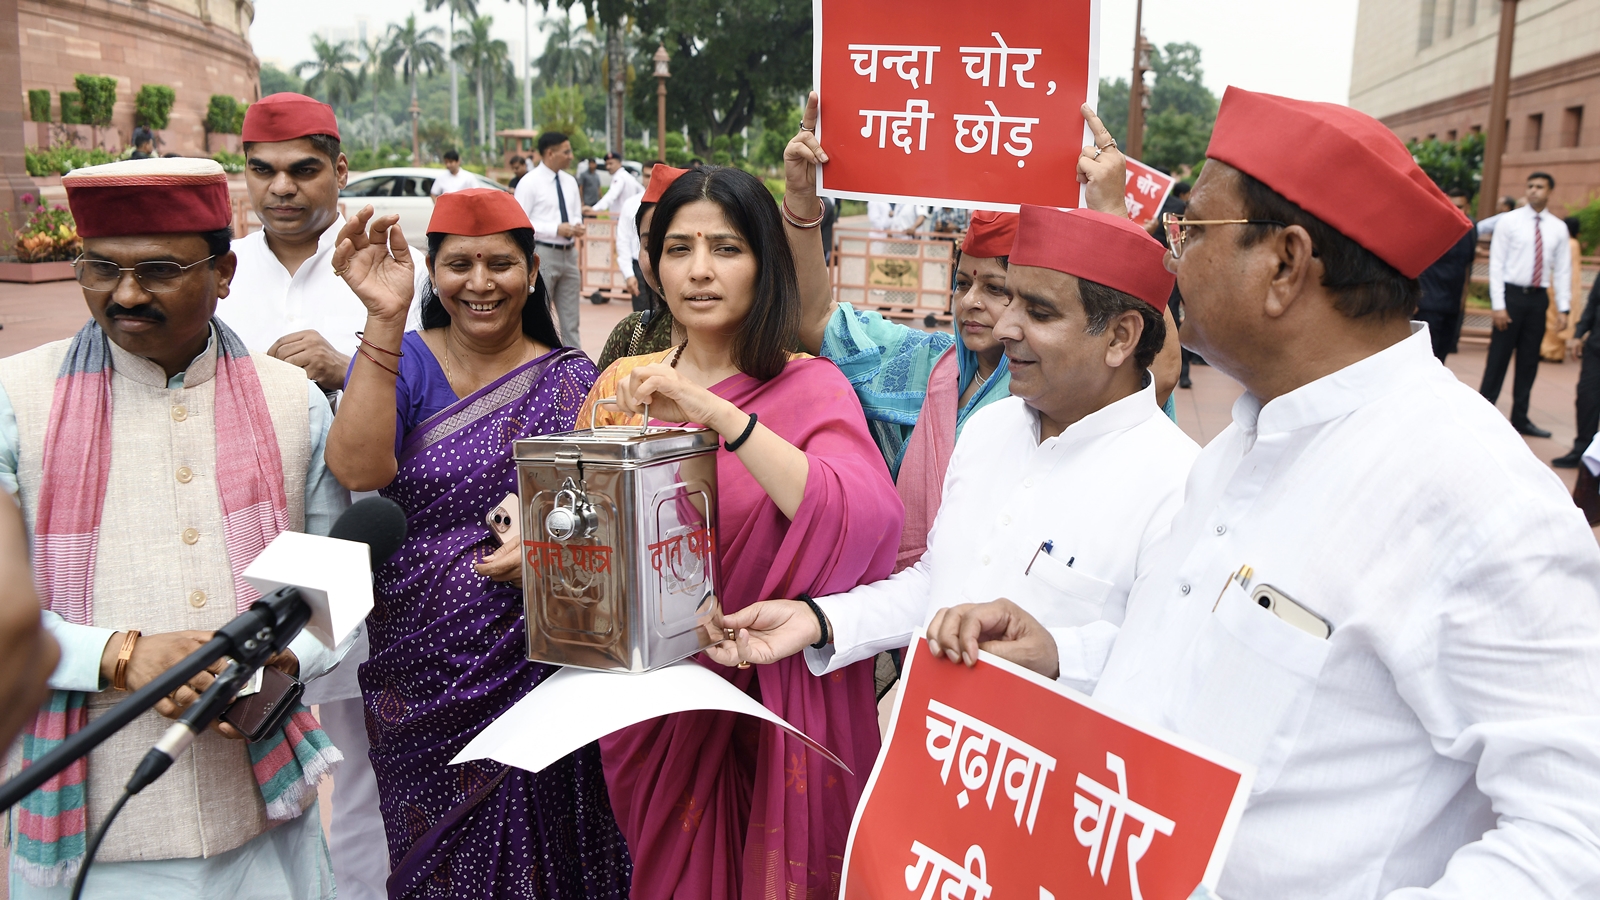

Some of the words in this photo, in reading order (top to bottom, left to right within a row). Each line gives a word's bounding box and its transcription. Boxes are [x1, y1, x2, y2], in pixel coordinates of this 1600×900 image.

[847, 43, 941, 90] चन्दा
[959, 31, 1058, 97] चोर,
[858, 98, 936, 156] गद्दी
[953, 100, 1040, 169] छोड़
[1136, 173, 1162, 200] चोर
[566, 543, 613, 576] पात्र
[925, 698, 1058, 836] चढ़ावा
[1073, 751, 1177, 900] चोर
